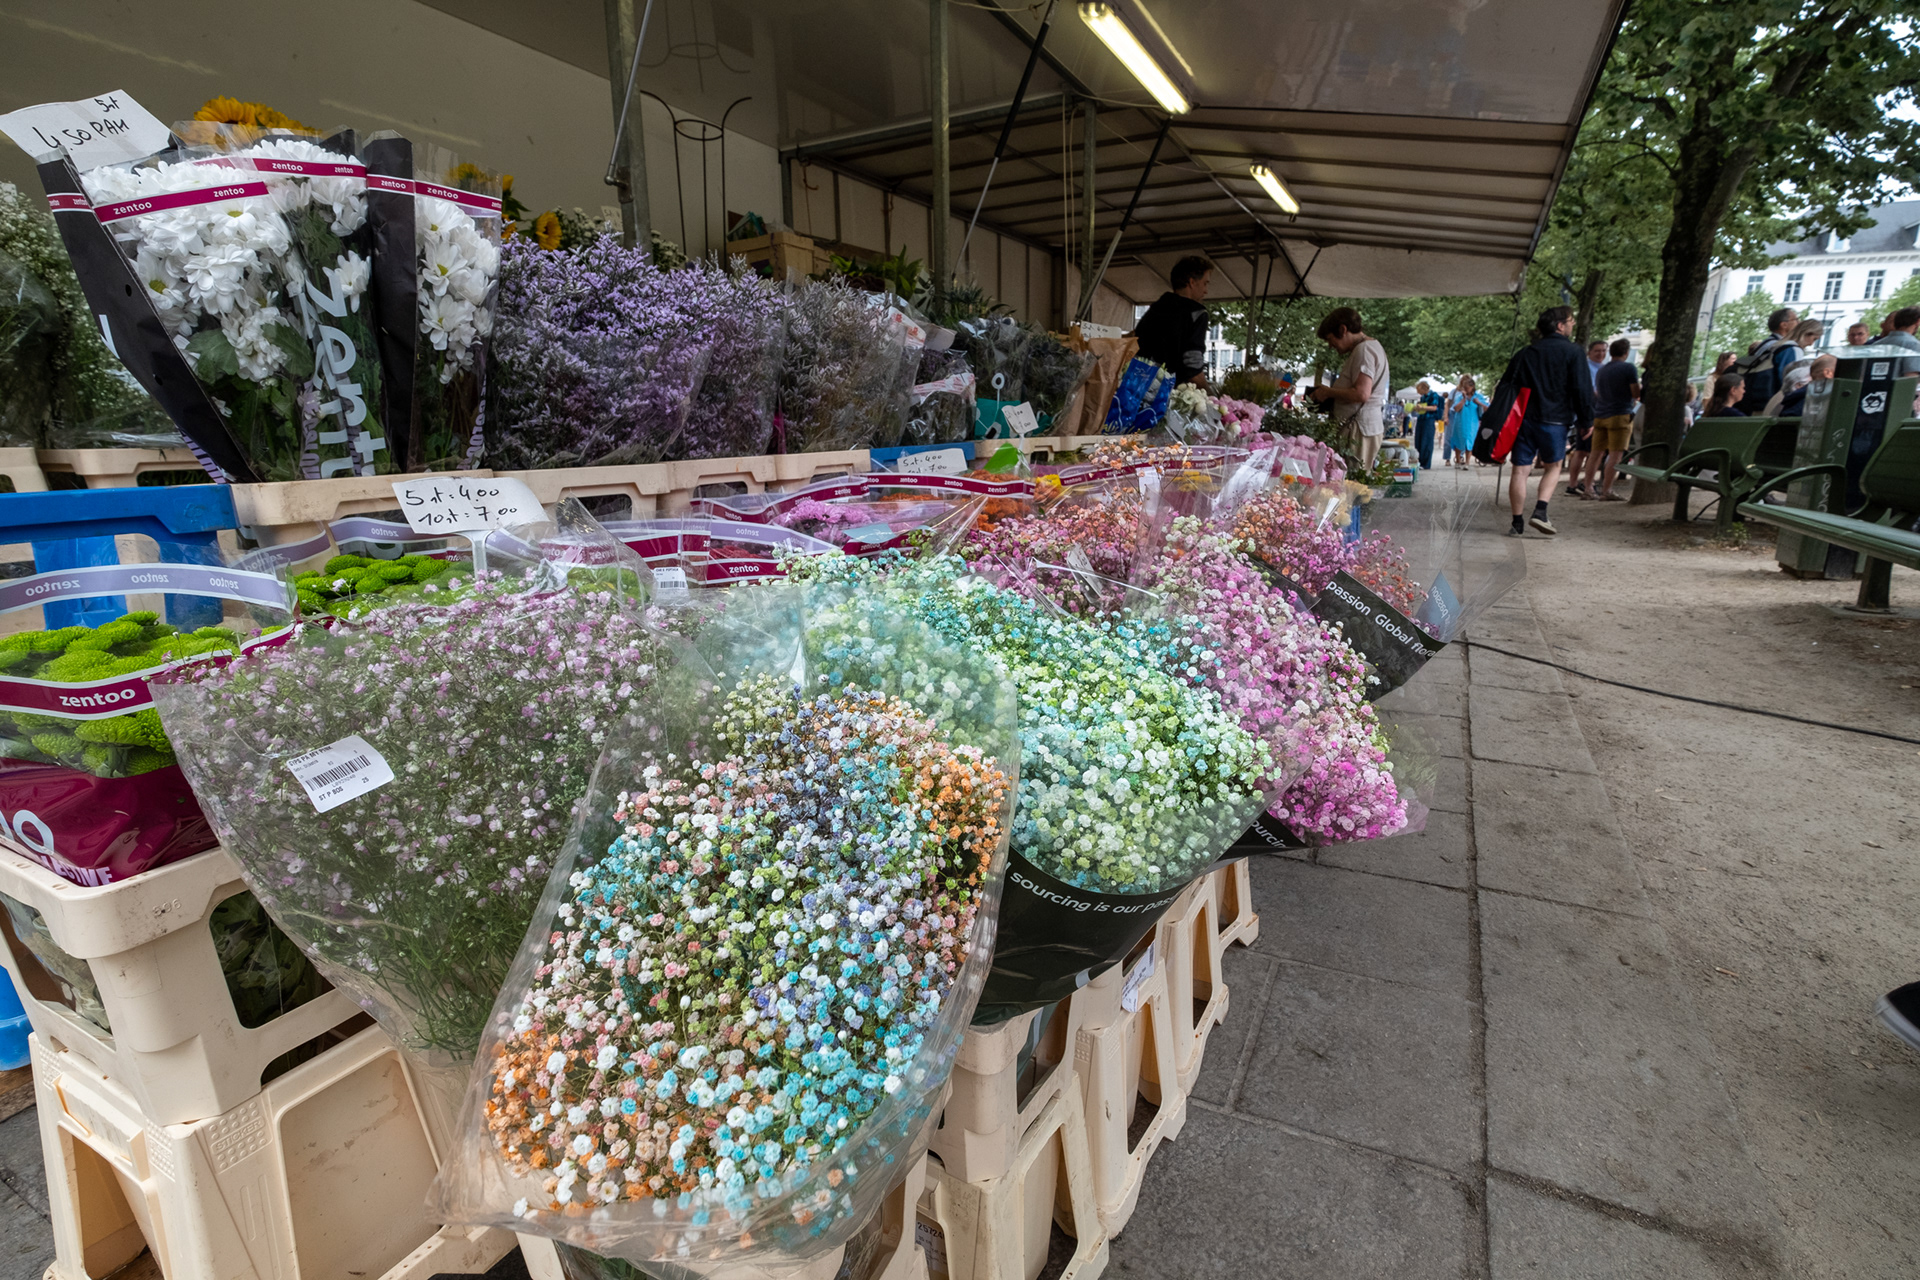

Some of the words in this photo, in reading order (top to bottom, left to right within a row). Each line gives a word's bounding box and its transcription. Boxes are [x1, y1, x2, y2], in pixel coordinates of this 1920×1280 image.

[272, 161, 304, 172] zentoo
[334, 166, 354, 174] zentoo
[380, 179, 406, 189] zentoo
[427, 187, 459, 199] zentoo
[113, 201, 152, 215] zentoo
[213, 187, 245, 197] zentoo
[729, 565, 760, 574] zentoo
[1325, 581, 1371, 616] passion
[1374, 613, 1413, 645] Global
[59, 687, 136, 708] zentoo
[1010, 873, 1091, 912] sourcing
[1093, 900, 1108, 912] is
[1112, 904, 1144, 914] our
[215, 1120, 261, 1151] STICKER
